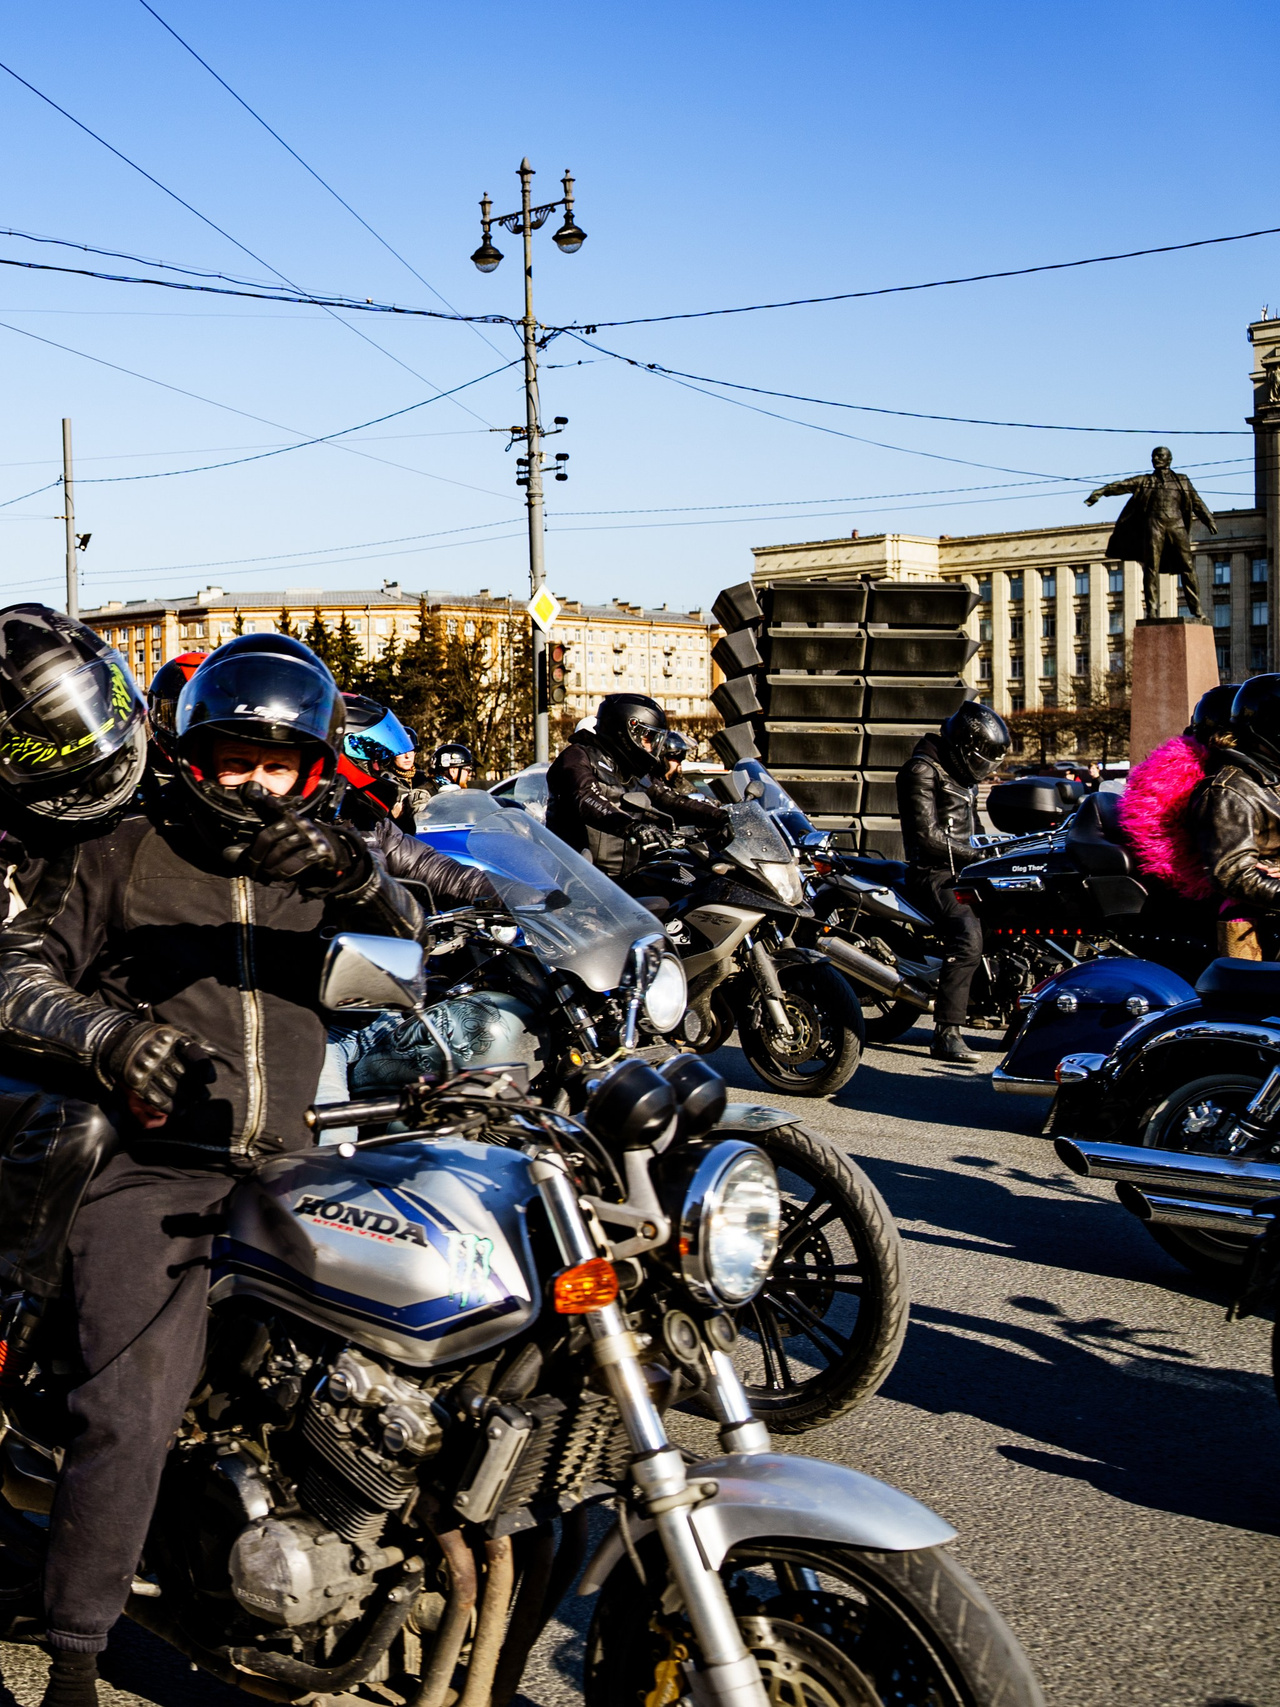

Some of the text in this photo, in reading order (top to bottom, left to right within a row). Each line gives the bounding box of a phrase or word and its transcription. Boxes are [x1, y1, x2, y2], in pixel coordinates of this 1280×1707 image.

[1011, 864, 1045, 873] Oleg Thor
[293, 1196, 428, 1248] HONDA
[312, 1217, 395, 1244] HYPER VTEC
